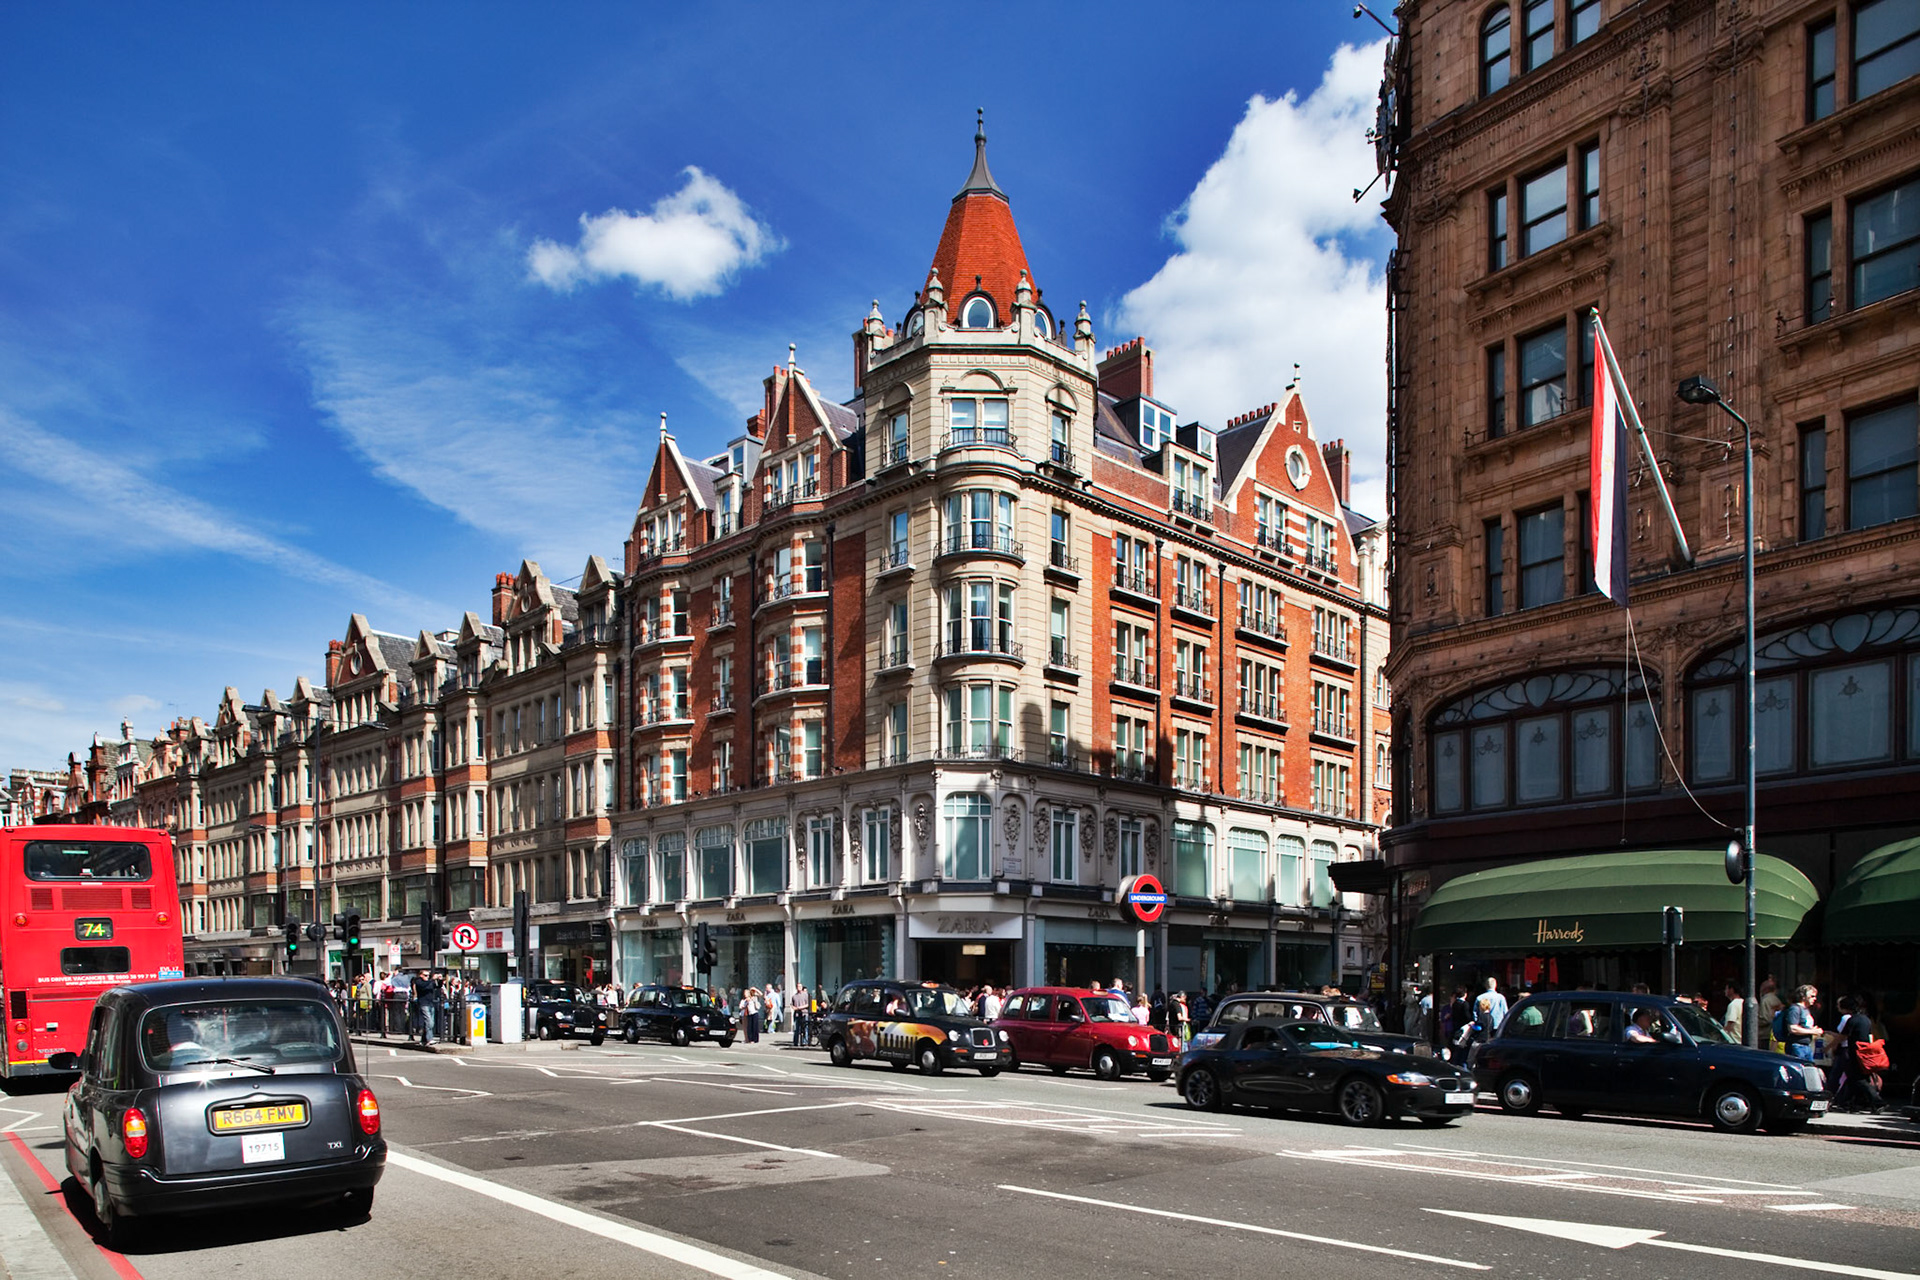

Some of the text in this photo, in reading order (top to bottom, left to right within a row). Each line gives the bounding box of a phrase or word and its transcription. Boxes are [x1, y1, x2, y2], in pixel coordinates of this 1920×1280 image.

[726, 912, 746, 922] ZARA
[832, 905, 855, 915] ZARA
[83, 923, 106, 937] 74
[937, 916, 993, 934] ZARA
[1532, 919, 1584, 943] Harrods
[223, 1106, 296, 1125] R664 FMV
[249, 1142, 280, 1153] 19715
